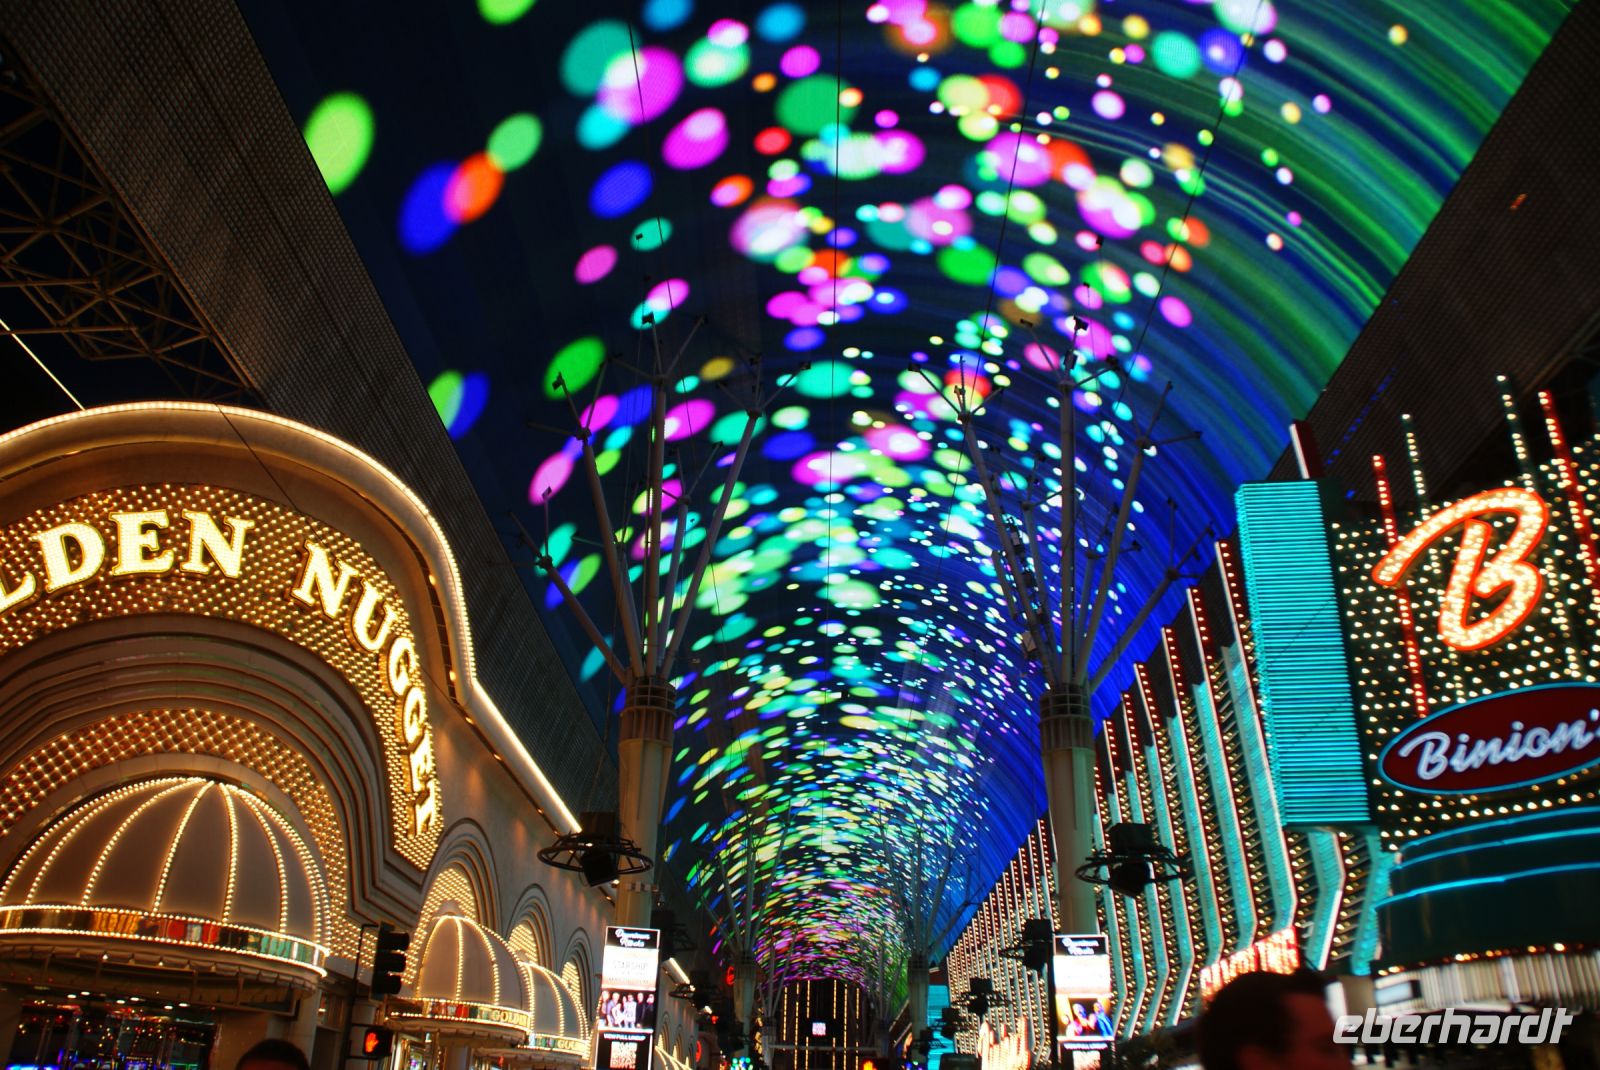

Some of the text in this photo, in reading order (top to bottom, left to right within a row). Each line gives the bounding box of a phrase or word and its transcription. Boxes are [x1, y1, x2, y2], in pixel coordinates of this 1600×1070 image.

[1372, 487, 1549, 651] B
[290, 538, 438, 838] NUGGET
[1399, 709, 1600, 780] Binion'
